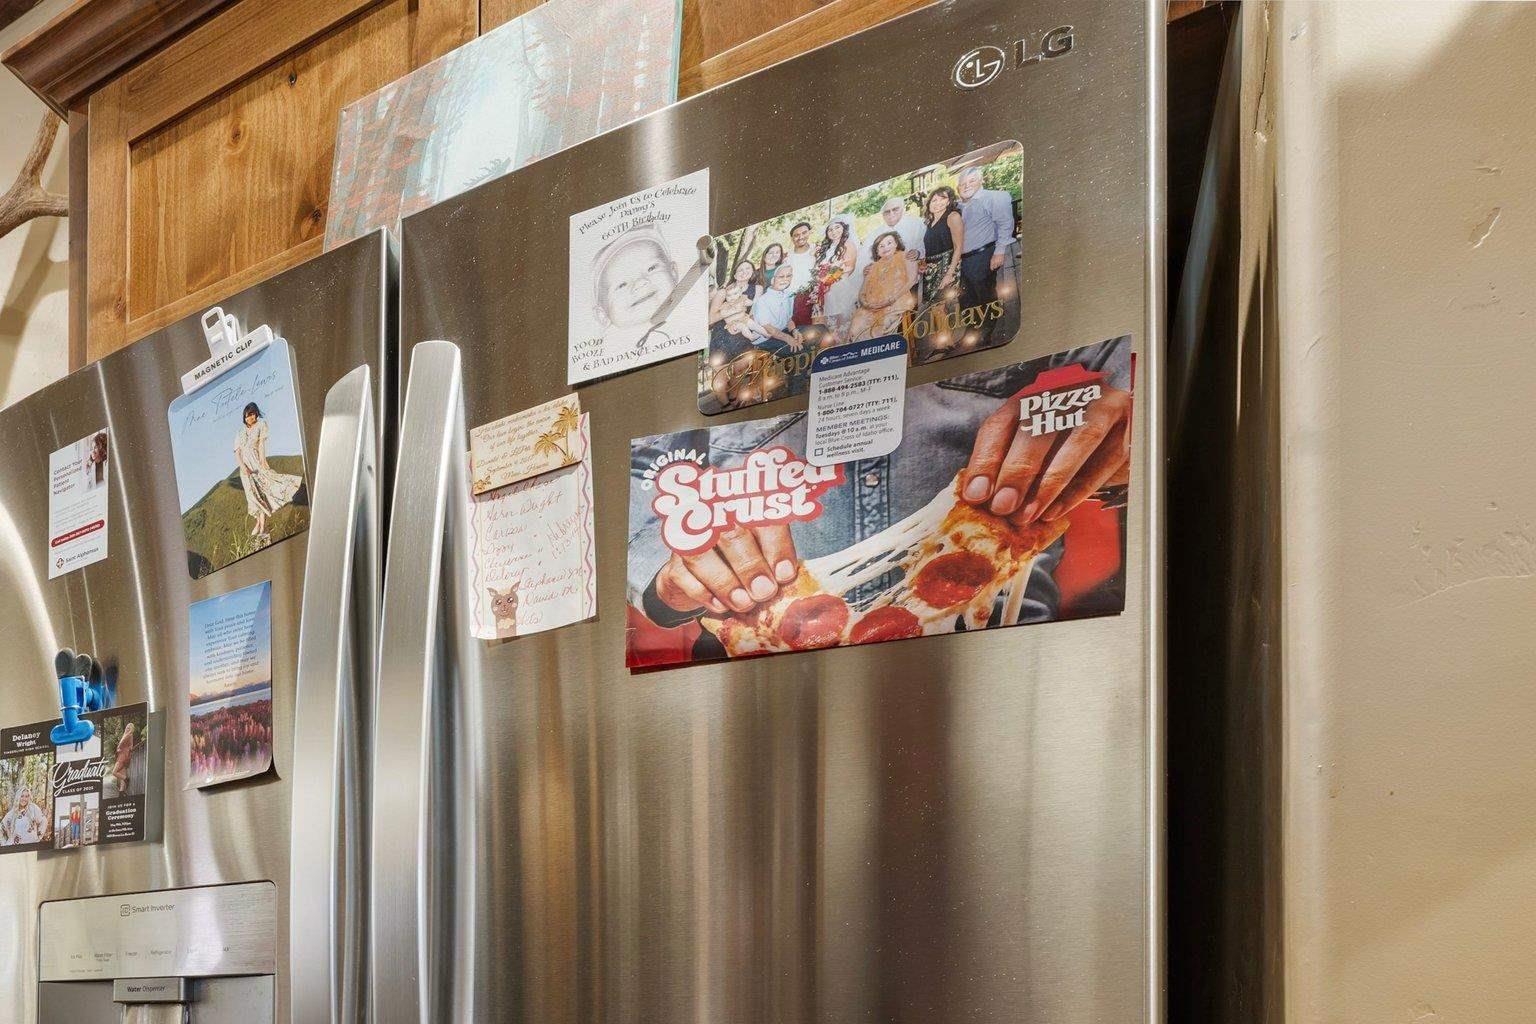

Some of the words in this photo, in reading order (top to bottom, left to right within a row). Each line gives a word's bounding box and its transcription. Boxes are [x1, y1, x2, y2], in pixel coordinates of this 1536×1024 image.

[1014, 25, 1074, 70] LG
[578, 212, 606, 235] Please
[608, 201, 628, 218] Join
[629, 194, 642, 204] Us
[643, 193, 653, 201] to
[654, 184, 697, 199] Celebrate
[631, 210, 672, 227] Birthday
[593, 357, 615, 369] BAD
[615, 346, 650, 362] DANCE
[652, 335, 692, 353] MOVES
[861, 340, 901, 357] MEDICARE
[194, 352, 234, 381] MAGNETIC
[235, 339, 253, 355] CLIP
[1019, 385, 1102, 421] Pizza
[816, 421, 848, 433] MEMBER
[1021, 408, 1087, 437] Hut
[815, 430, 840, 440] Tuesdays
[826, 443, 852, 453] Schedule
[641, 449, 707, 491] ORIGINAL
[663, 485, 816, 551] Crust
[12, 731, 41, 743] Delaney
[16, 739, 37, 749] Wright
[51, 757, 110, 797] Graduate
[105, 807, 137, 816] Graduation
[131, 904, 150, 914] Smart
[127, 985, 142, 993] Water
[142, 985, 166, 994] Dispenser
